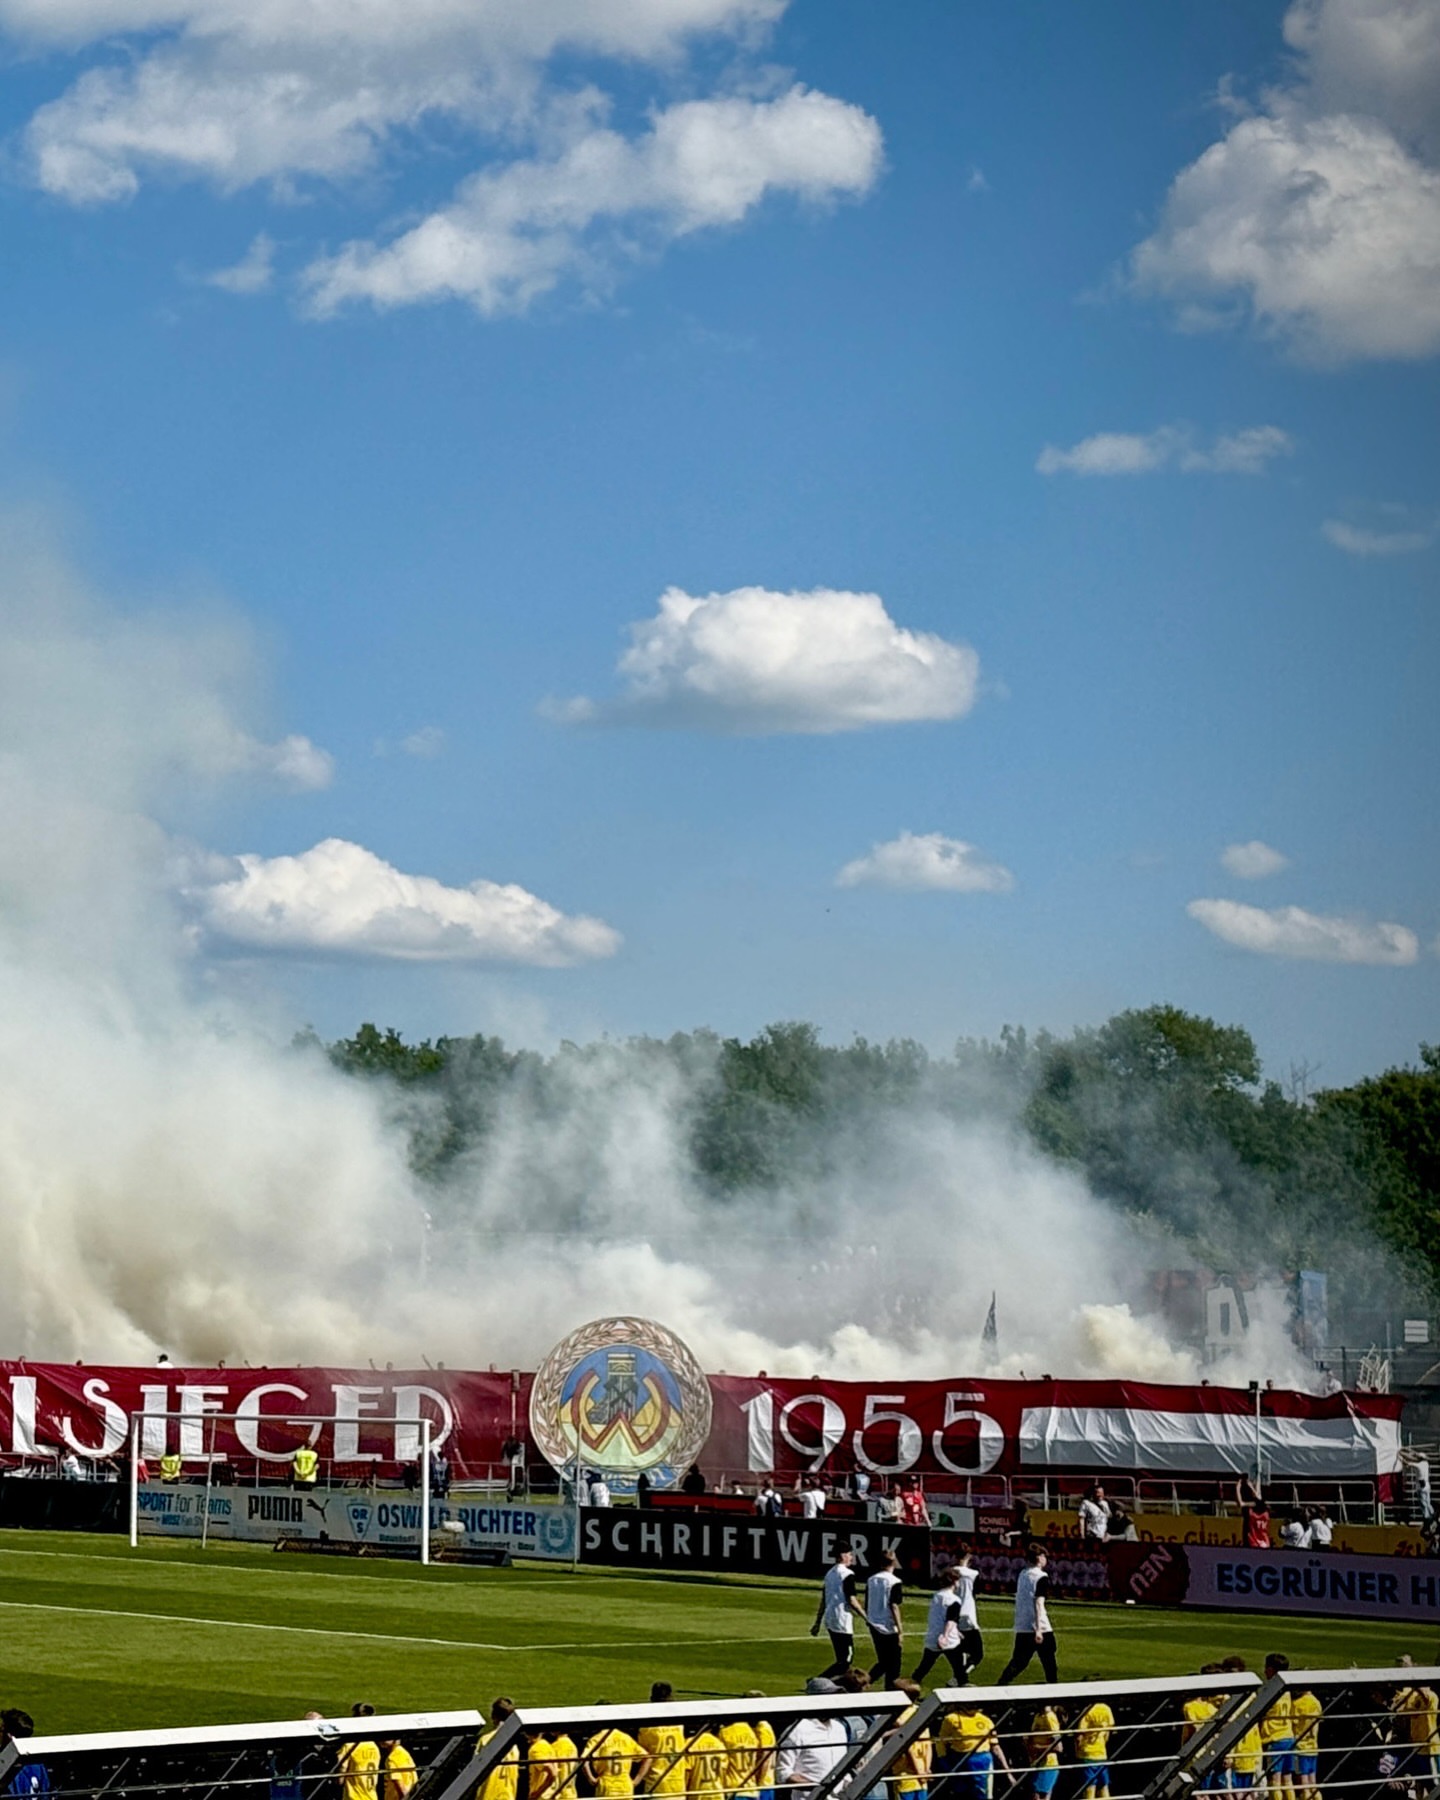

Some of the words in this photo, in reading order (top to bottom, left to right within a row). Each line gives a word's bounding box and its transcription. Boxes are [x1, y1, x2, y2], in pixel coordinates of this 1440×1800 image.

[0, 1374, 452, 1462] LSIEGER
[739, 1388, 1004, 1475] 1955
[139, 1492, 174, 1513] SPORT
[176, 1494, 193, 1513] for
[195, 1495, 232, 1515] Teams
[248, 1495, 303, 1522] PUMA
[459, 1508, 536, 1536] RICHTER
[584, 1518, 903, 1569] SCHRIFTWERK
[1129, 1545, 1172, 1596] NEU
[1217, 1559, 1400, 1604] ESGRÜNER
[1411, 1575, 1440, 1607] H
[611, 1751, 622, 1776] 6
